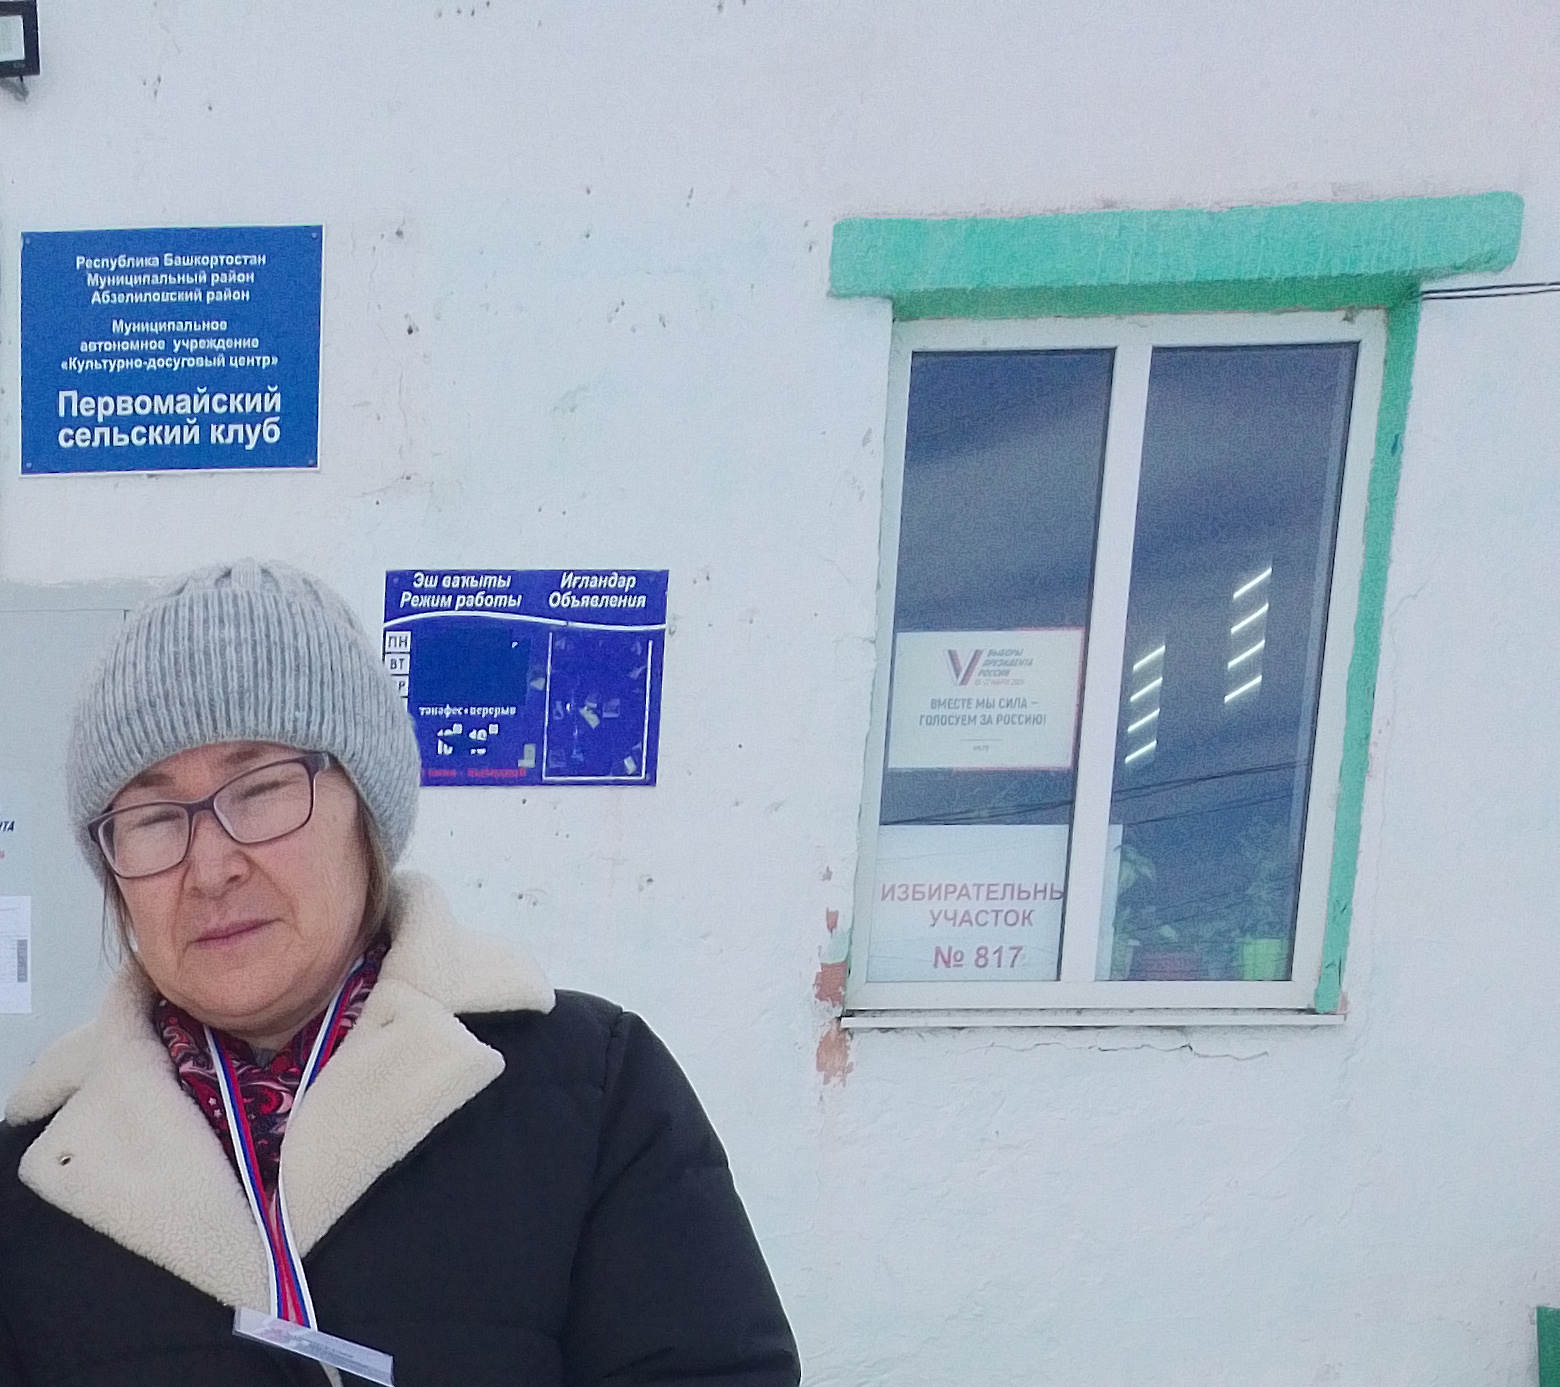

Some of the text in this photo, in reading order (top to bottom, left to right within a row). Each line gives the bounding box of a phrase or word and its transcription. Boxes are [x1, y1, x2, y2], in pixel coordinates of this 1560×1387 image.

[76, 253, 266, 272] Республика Башкортостан
[86, 269, 254, 289] Муниципальный район
[91, 289, 249, 305] Абзелиловский район
[112, 318, 228, 336] Муниципальное
[80, 337, 259, 353] автономное учреждение
[61, 353, 278, 373] «Культурно-досуговый центр»
[58, 385, 281, 422] Первомайский
[58, 416, 281, 450] сельский клуб
[413, 571, 438, 589] Эш
[400, 591, 522, 611] Режим работы
[548, 591, 646, 608] Объявления
[388, 636, 408, 648] ПН
[390, 658, 405, 670] ВТ
[930, 697, 973, 710] ВМЕСТЕ
[975, 697, 995, 709] МЫ
[998, 697, 1028, 709] СИЛА
[919, 713, 1047, 727] ГОЛОСУЕМ ЗА РОССИЮ!
[929, 909, 1034, 928] УЧАСТОК
[933, 945, 1023, 968] № 817
